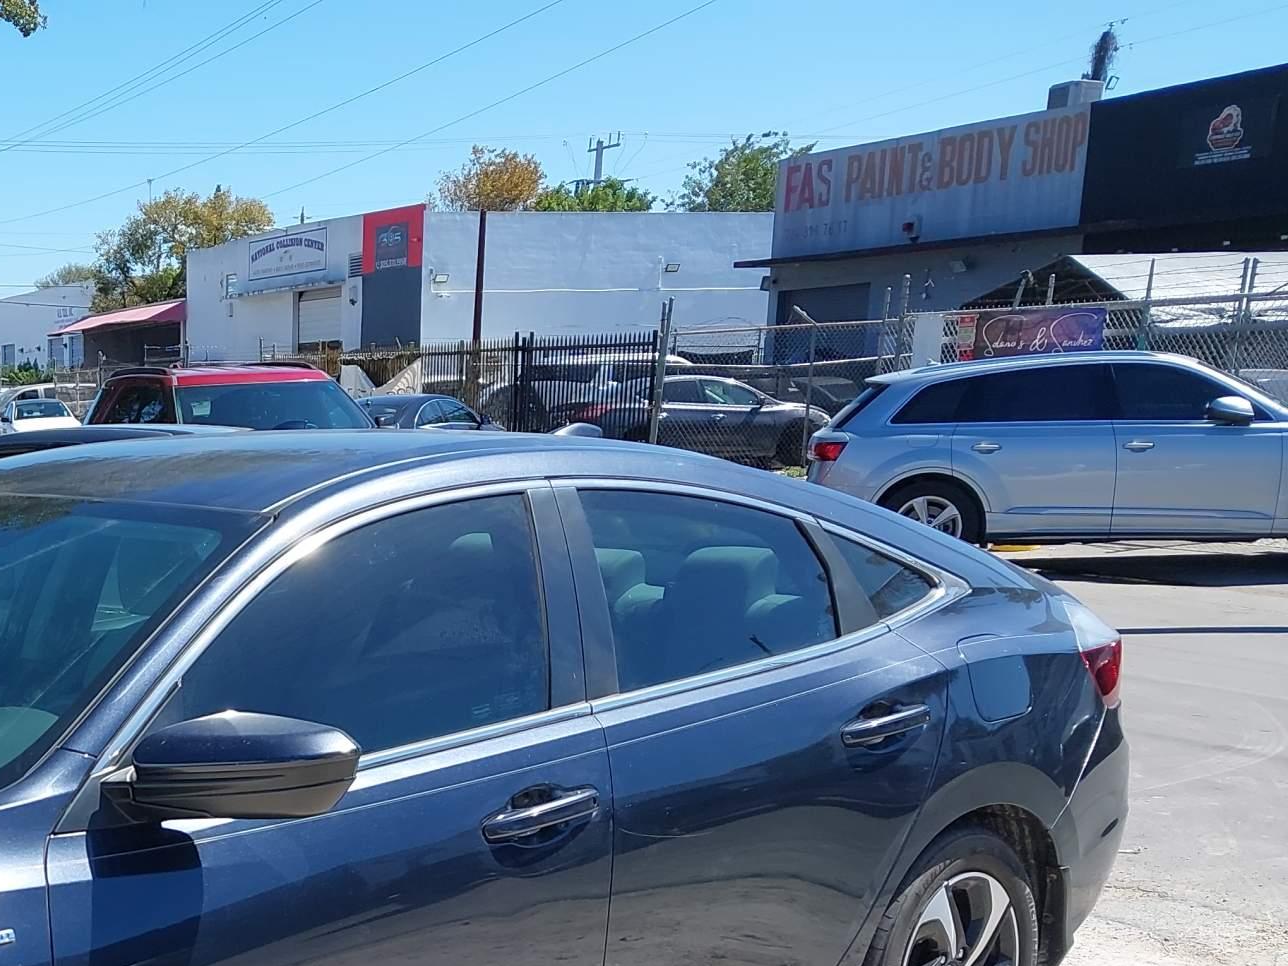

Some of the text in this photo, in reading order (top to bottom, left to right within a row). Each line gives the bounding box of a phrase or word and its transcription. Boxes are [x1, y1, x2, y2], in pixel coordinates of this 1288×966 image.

[783, 159, 833, 214] FAS
[844, 142, 923, 203] PAINT
[936, 125, 1018, 190] BODY
[1021, 111, 1088, 178] SHOP
[251, 237, 324, 264] NATIONAL COLLISION CENTER
[1029, 327, 1048, 351] &
